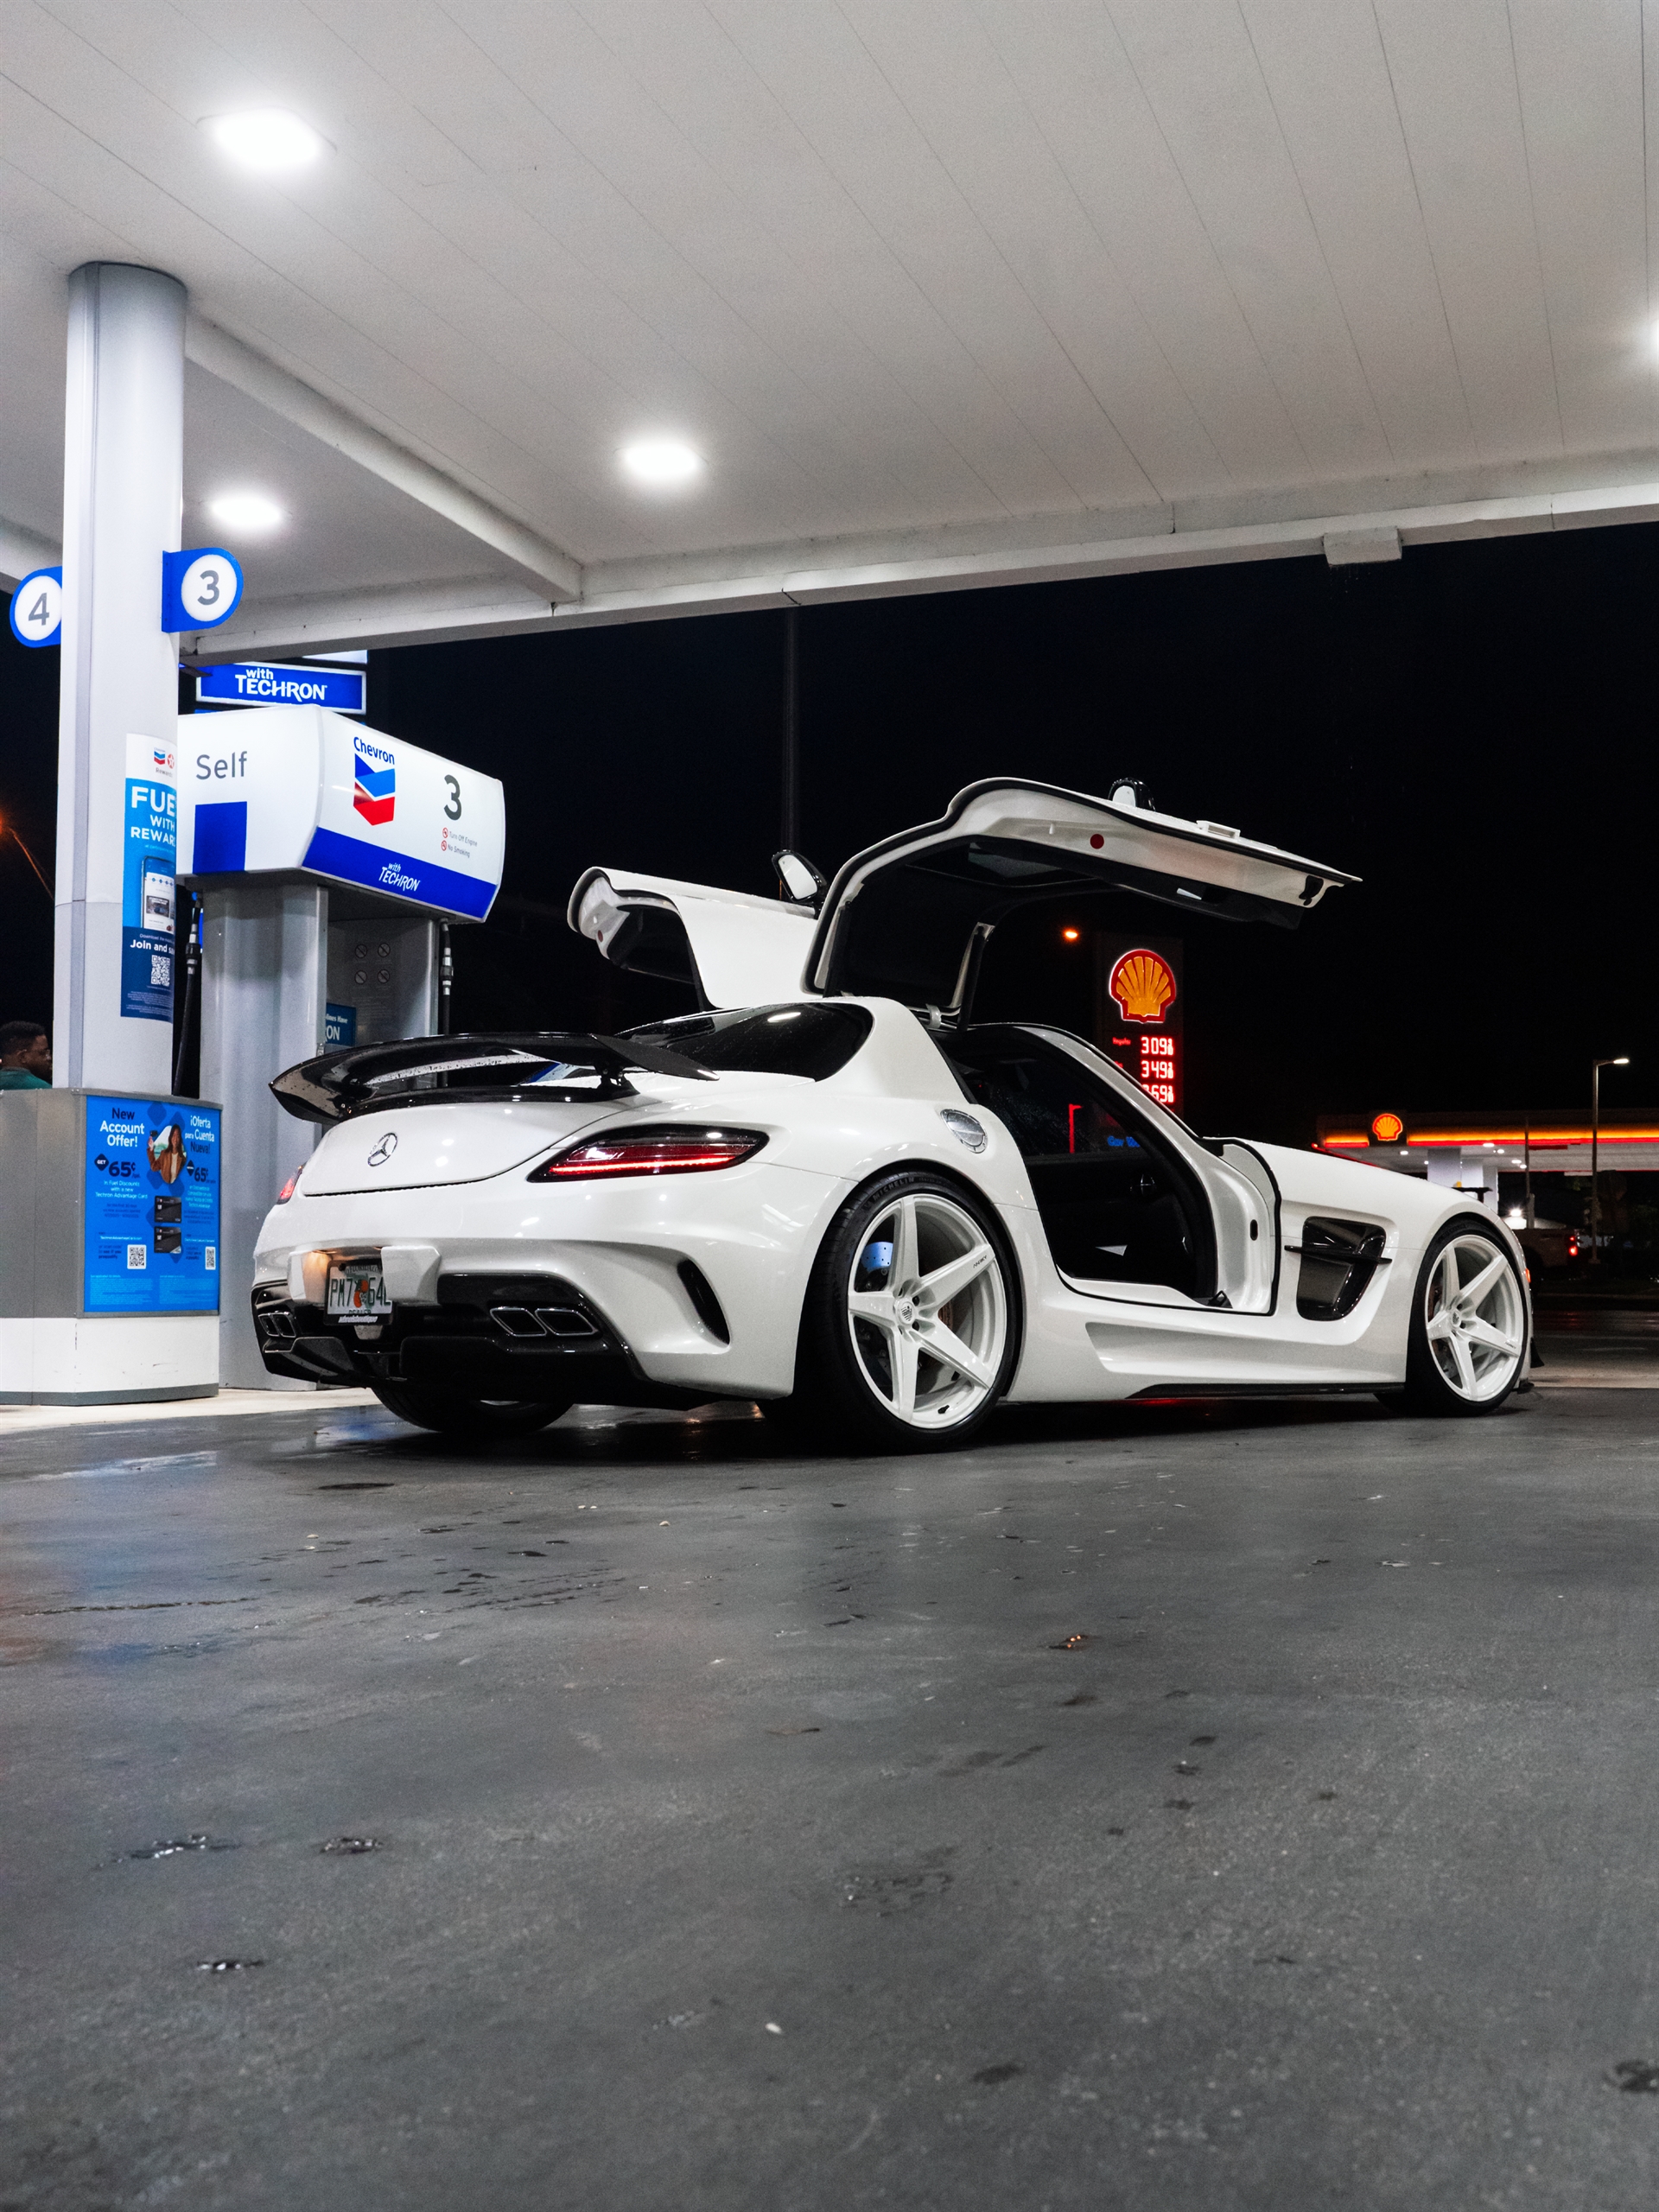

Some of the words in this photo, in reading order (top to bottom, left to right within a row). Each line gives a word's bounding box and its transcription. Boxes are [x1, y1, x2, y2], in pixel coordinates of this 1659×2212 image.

[197, 570, 219, 605] 3
[29, 593, 49, 626] 4
[246, 668, 273, 679] with
[235, 674, 325, 702] TECHRON
[353, 737, 395, 765] Chevron
[196, 751, 247, 779] Self
[131, 785, 176, 817] FUE
[443, 774, 462, 821] 3
[149, 814, 175, 832] WITH
[130, 826, 175, 848] REWAR
[454, 846, 470, 858] Smoking
[388, 863, 401, 873] with
[378, 867, 420, 891] TECHRON
[130, 939, 151, 950] Join
[154, 943, 168, 952] and
[325, 1025, 340, 1042] ON
[111, 1108, 135, 1120] New
[99, 1120, 144, 1135] Account
[194, 1128, 214, 1142] Cuenta
[107, 1134, 137, 1147] Offer!
[191, 1141, 211, 1154] Nueva!
[873, 1177, 914, 1202] MICHELIN
